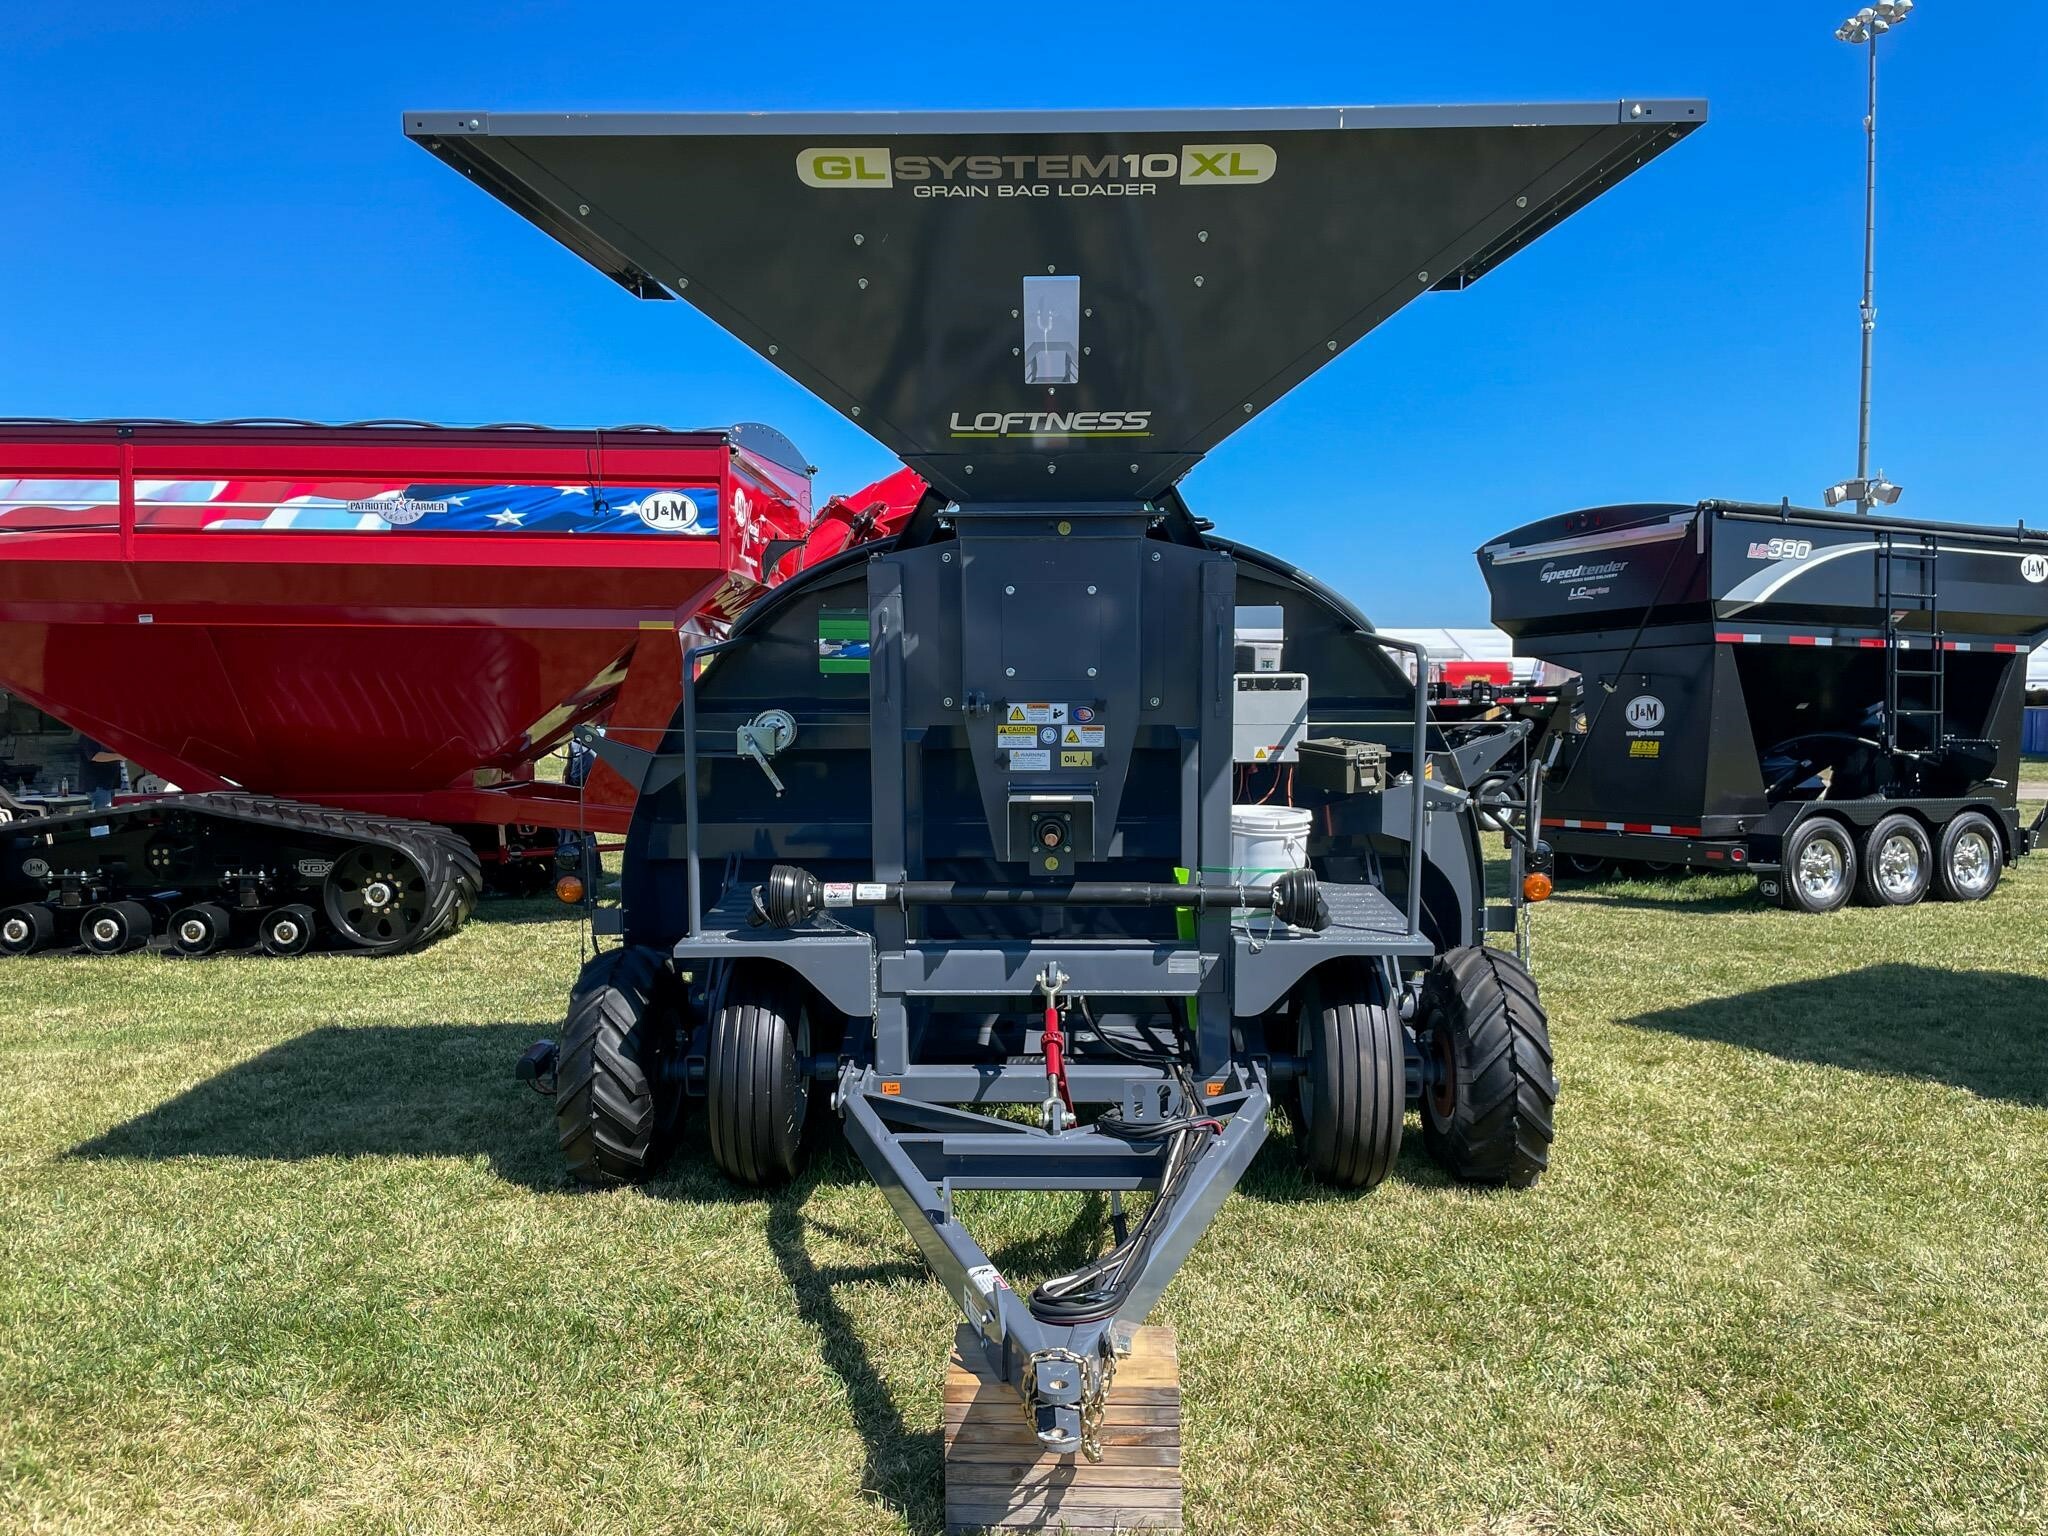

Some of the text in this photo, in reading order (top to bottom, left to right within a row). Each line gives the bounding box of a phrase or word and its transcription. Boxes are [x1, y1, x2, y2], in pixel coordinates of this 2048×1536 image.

[813, 156, 886, 180] GL
[1188, 152, 1259, 177] XL
[913, 183, 1157, 198] GRAIN BAG LOADER
[950, 411, 1152, 434] LOFTNESS
[349, 502, 445, 511] PATRIOTIC FARMER
[646, 500, 688, 521] J&M
[383, 511, 419, 521] EDITION
[2023, 559, 2045, 577] J&M
[1630, 703, 1658, 721] J&M
[1064, 755, 1078, 763] OIL
